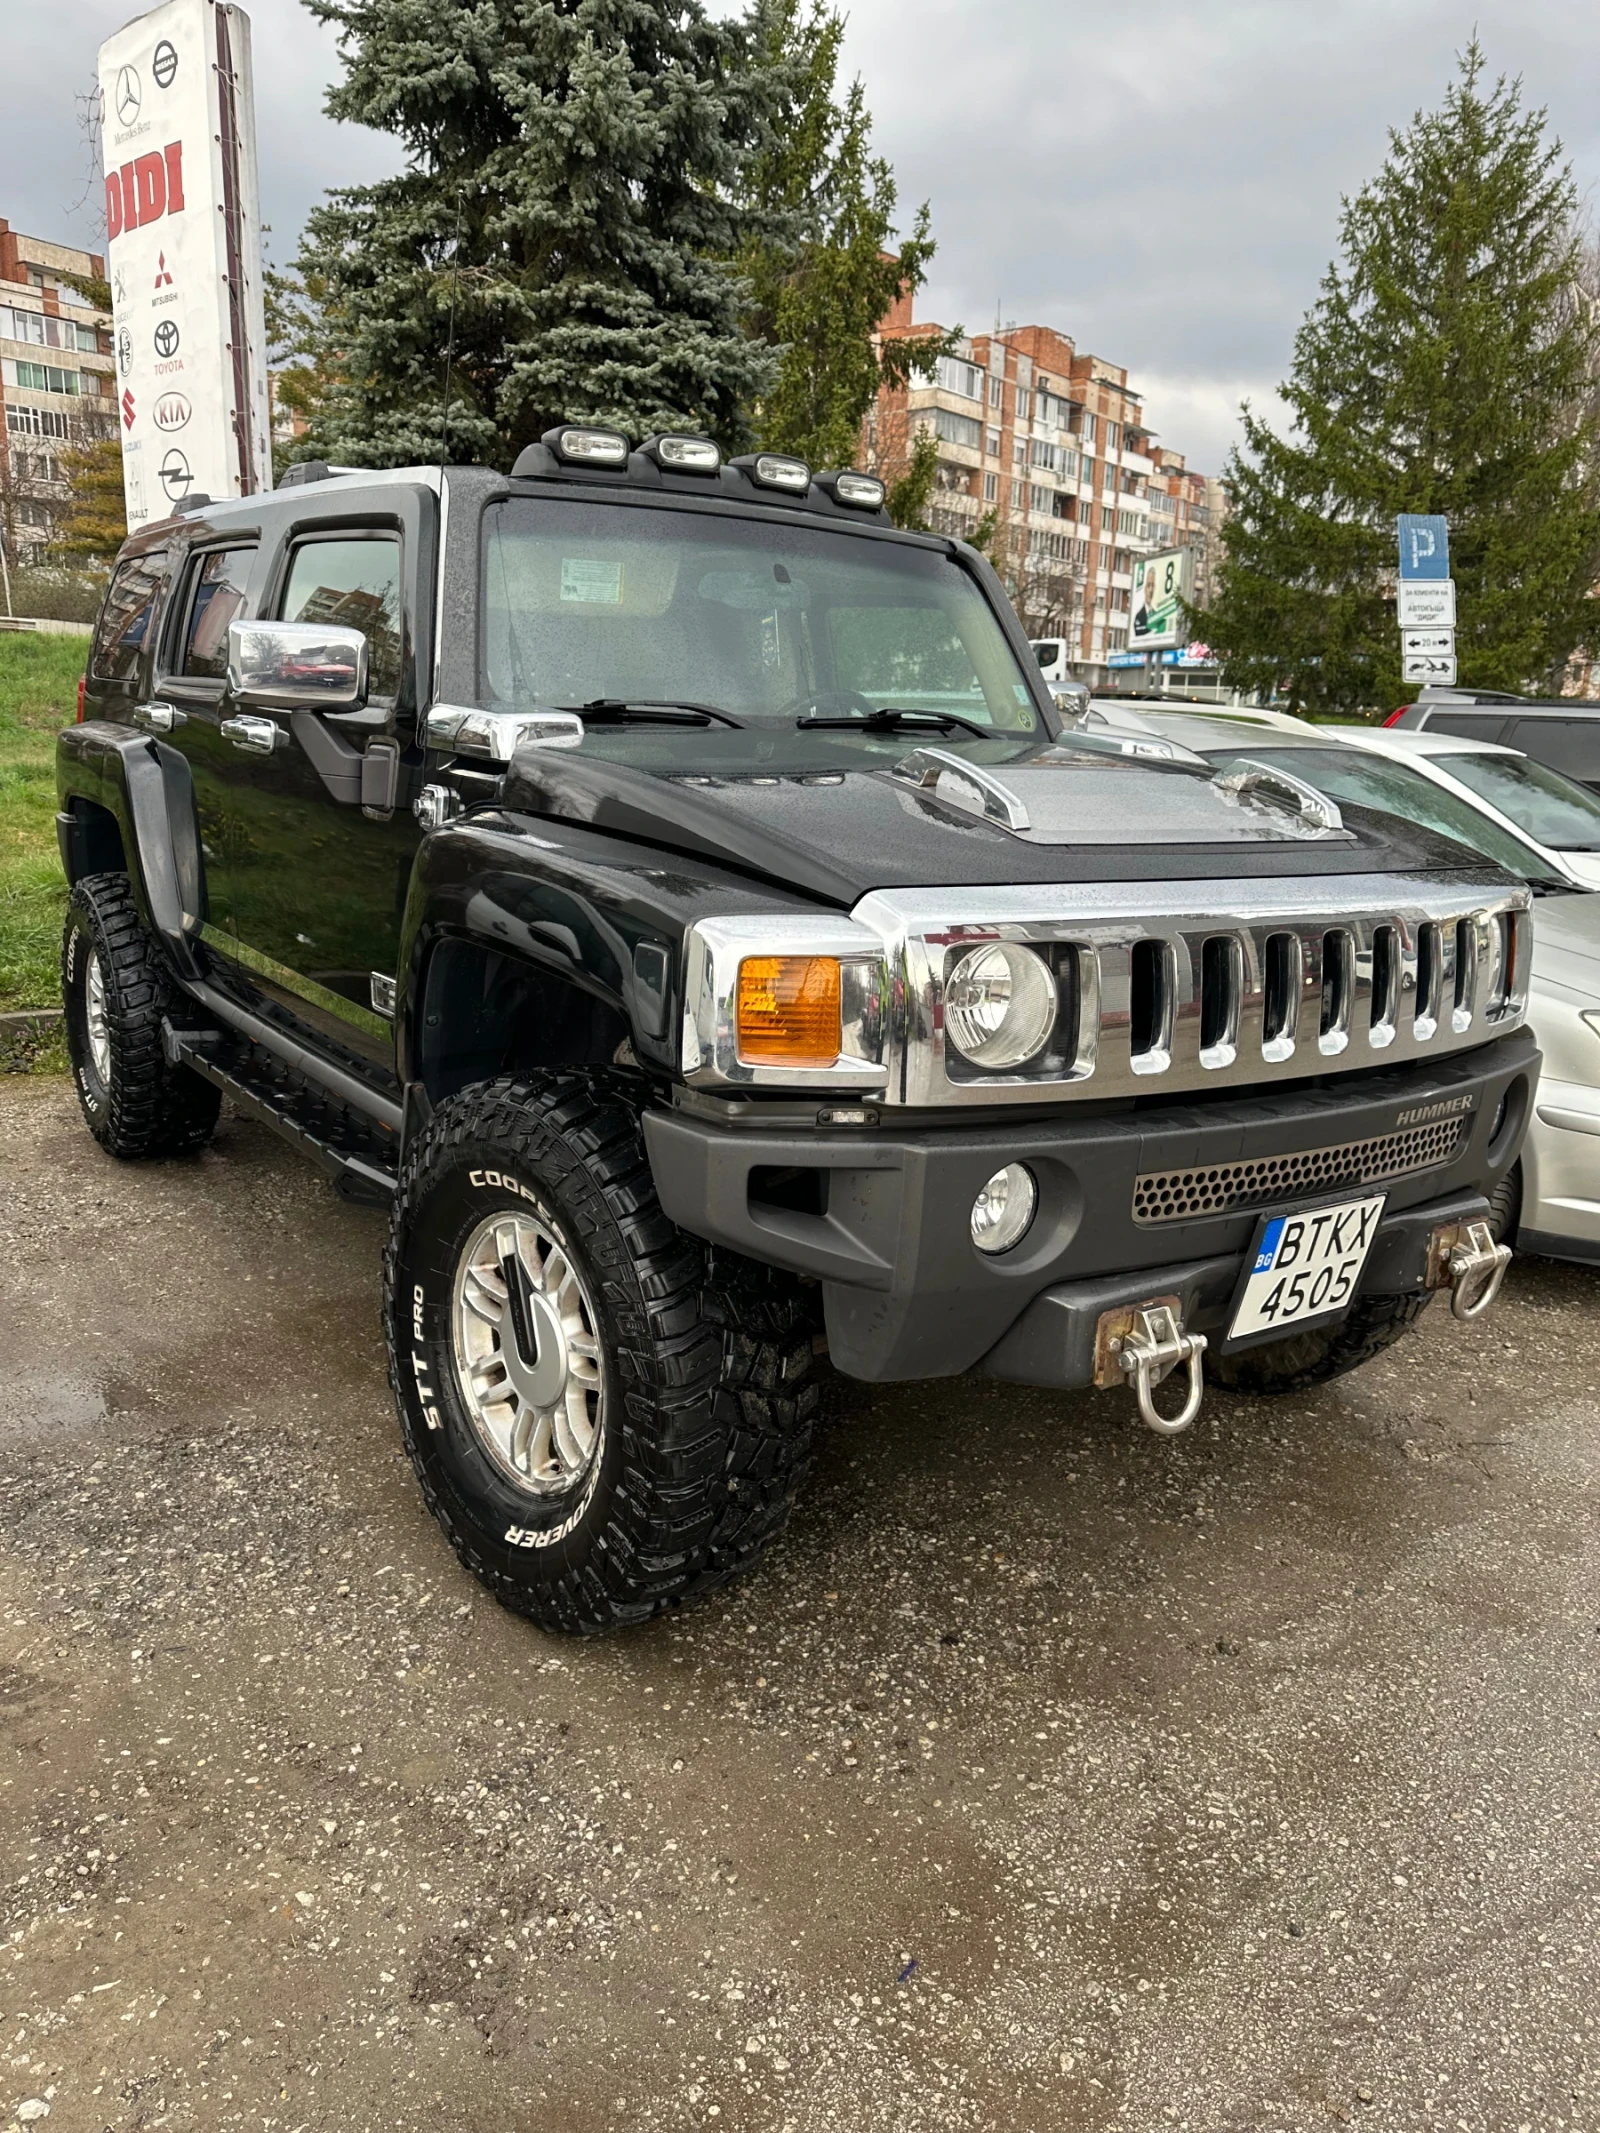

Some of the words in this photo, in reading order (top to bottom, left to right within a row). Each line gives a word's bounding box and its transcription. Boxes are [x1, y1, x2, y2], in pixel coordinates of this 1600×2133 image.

[105, 140, 184, 243] DIDI
[151, 291, 178, 308] MITSUBISHI
[154, 358, 184, 377] TOYOTA
[160, 402, 185, 425] KIA
[1411, 527, 1436, 569] P
[1165, 560, 1174, 594] 8
[1421, 638, 1431, 647] 20
[67, 924, 81, 983] COOPER
[85, 1094, 98, 1112] STT
[1396, 1094, 1473, 1127] HUMMER
[1274, 1203, 1379, 1270] BTKX
[1254, 1252, 1274, 1269] BG
[1259, 1259, 1358, 1322] 4505
[413, 1284, 425, 1342] PRO
[411, 1350, 444, 1430] STT
